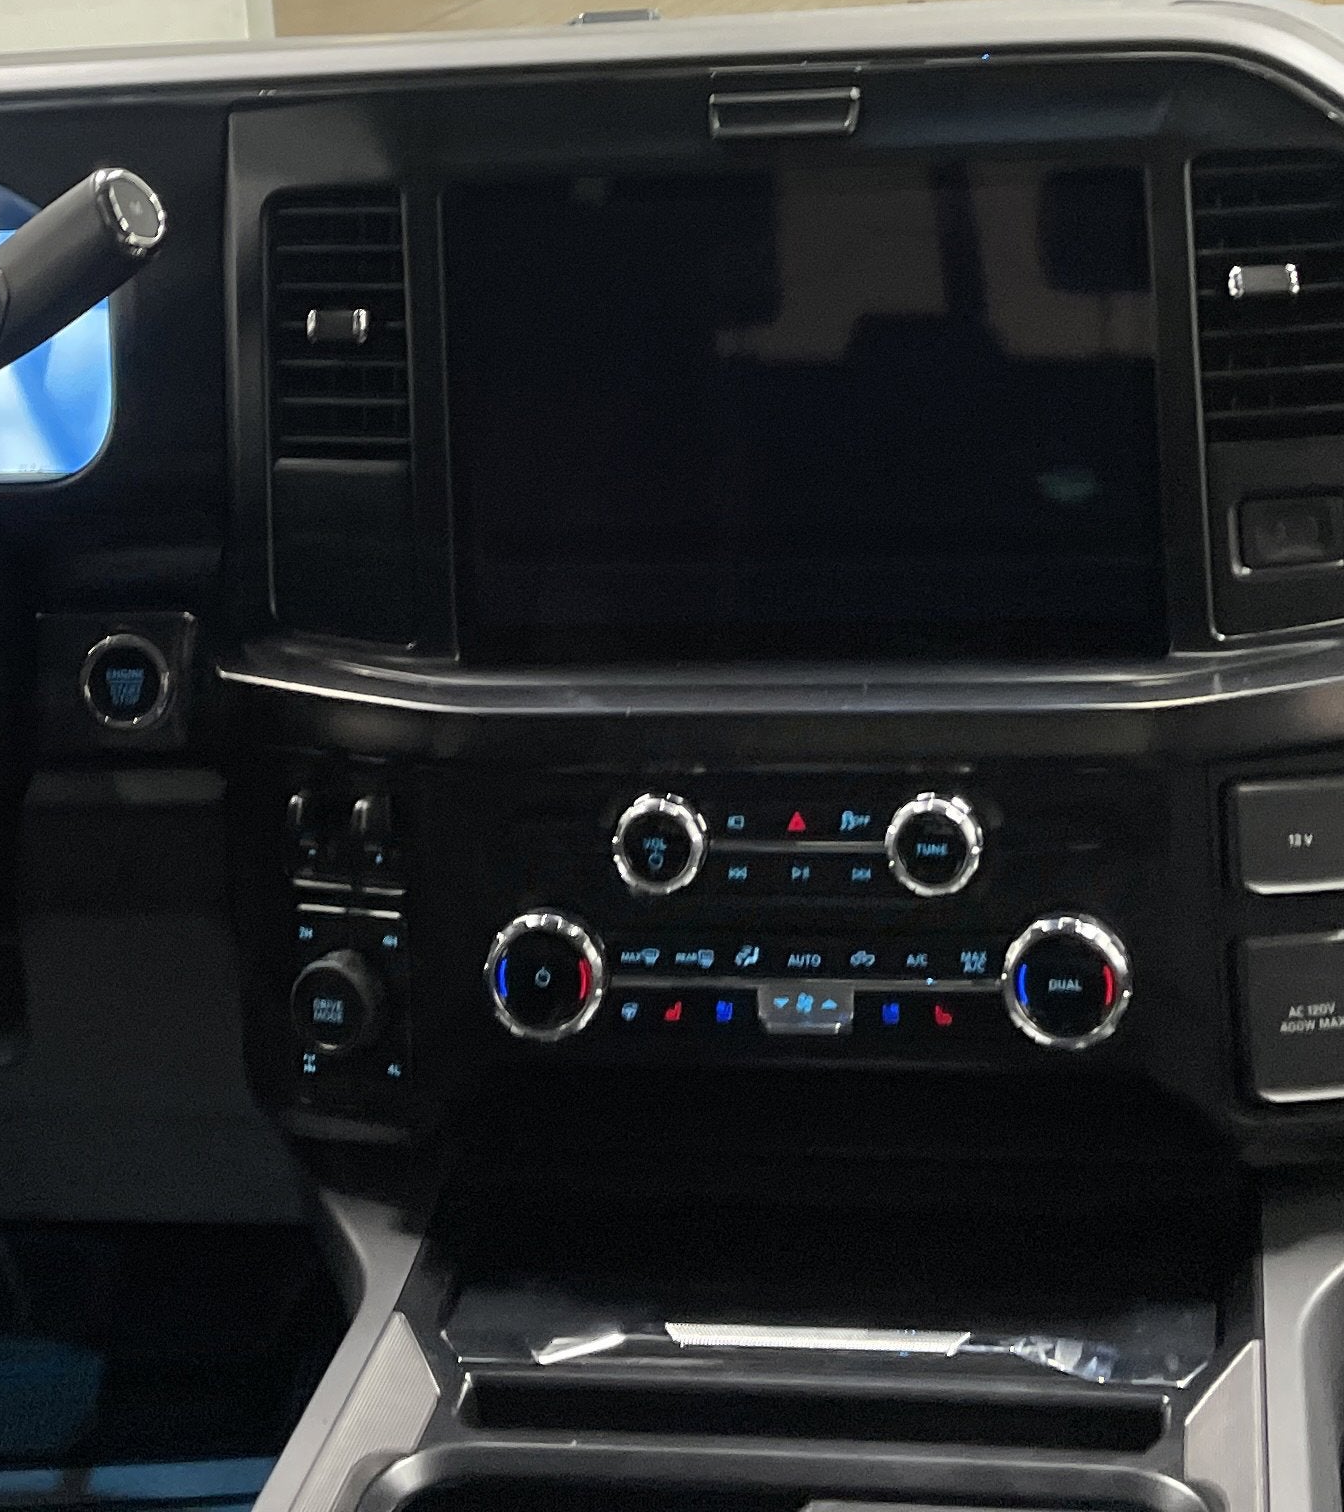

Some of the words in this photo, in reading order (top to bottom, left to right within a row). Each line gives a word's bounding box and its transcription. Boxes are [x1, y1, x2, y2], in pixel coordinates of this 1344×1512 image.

[787, 953, 821, 967] AUTO
[906, 953, 928, 967] A/C
[1048, 978, 1083, 992] DUAL
[1288, 1004, 1305, 1018] AC
